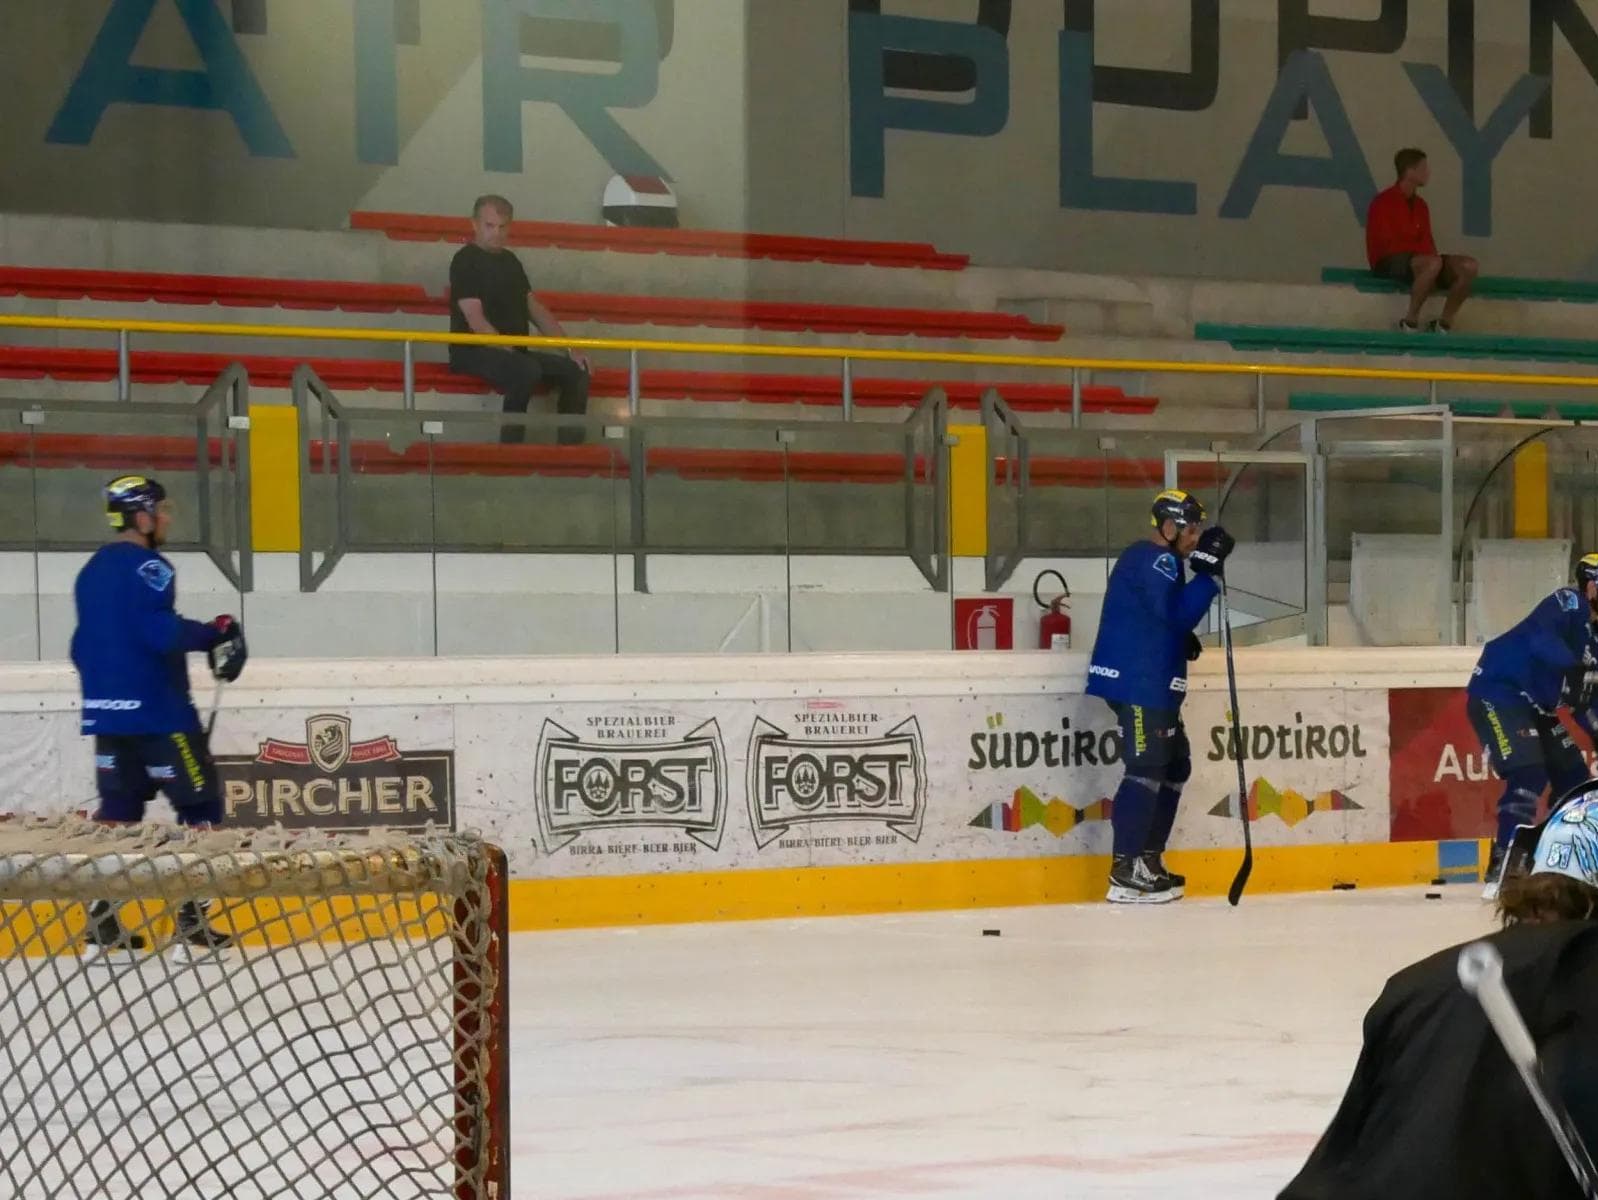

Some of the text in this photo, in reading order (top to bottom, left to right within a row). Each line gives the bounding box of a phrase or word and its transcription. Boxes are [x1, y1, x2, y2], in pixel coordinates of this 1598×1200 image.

[849, 12, 1553, 237] PLAY
[597, 728, 668, 739] BRAUEREI
[804, 725, 869, 735] BRAUEREI
[224, 775, 438, 818] PIRCHER
[553, 757, 713, 817] FORST
[763, 753, 912, 811] FORST
